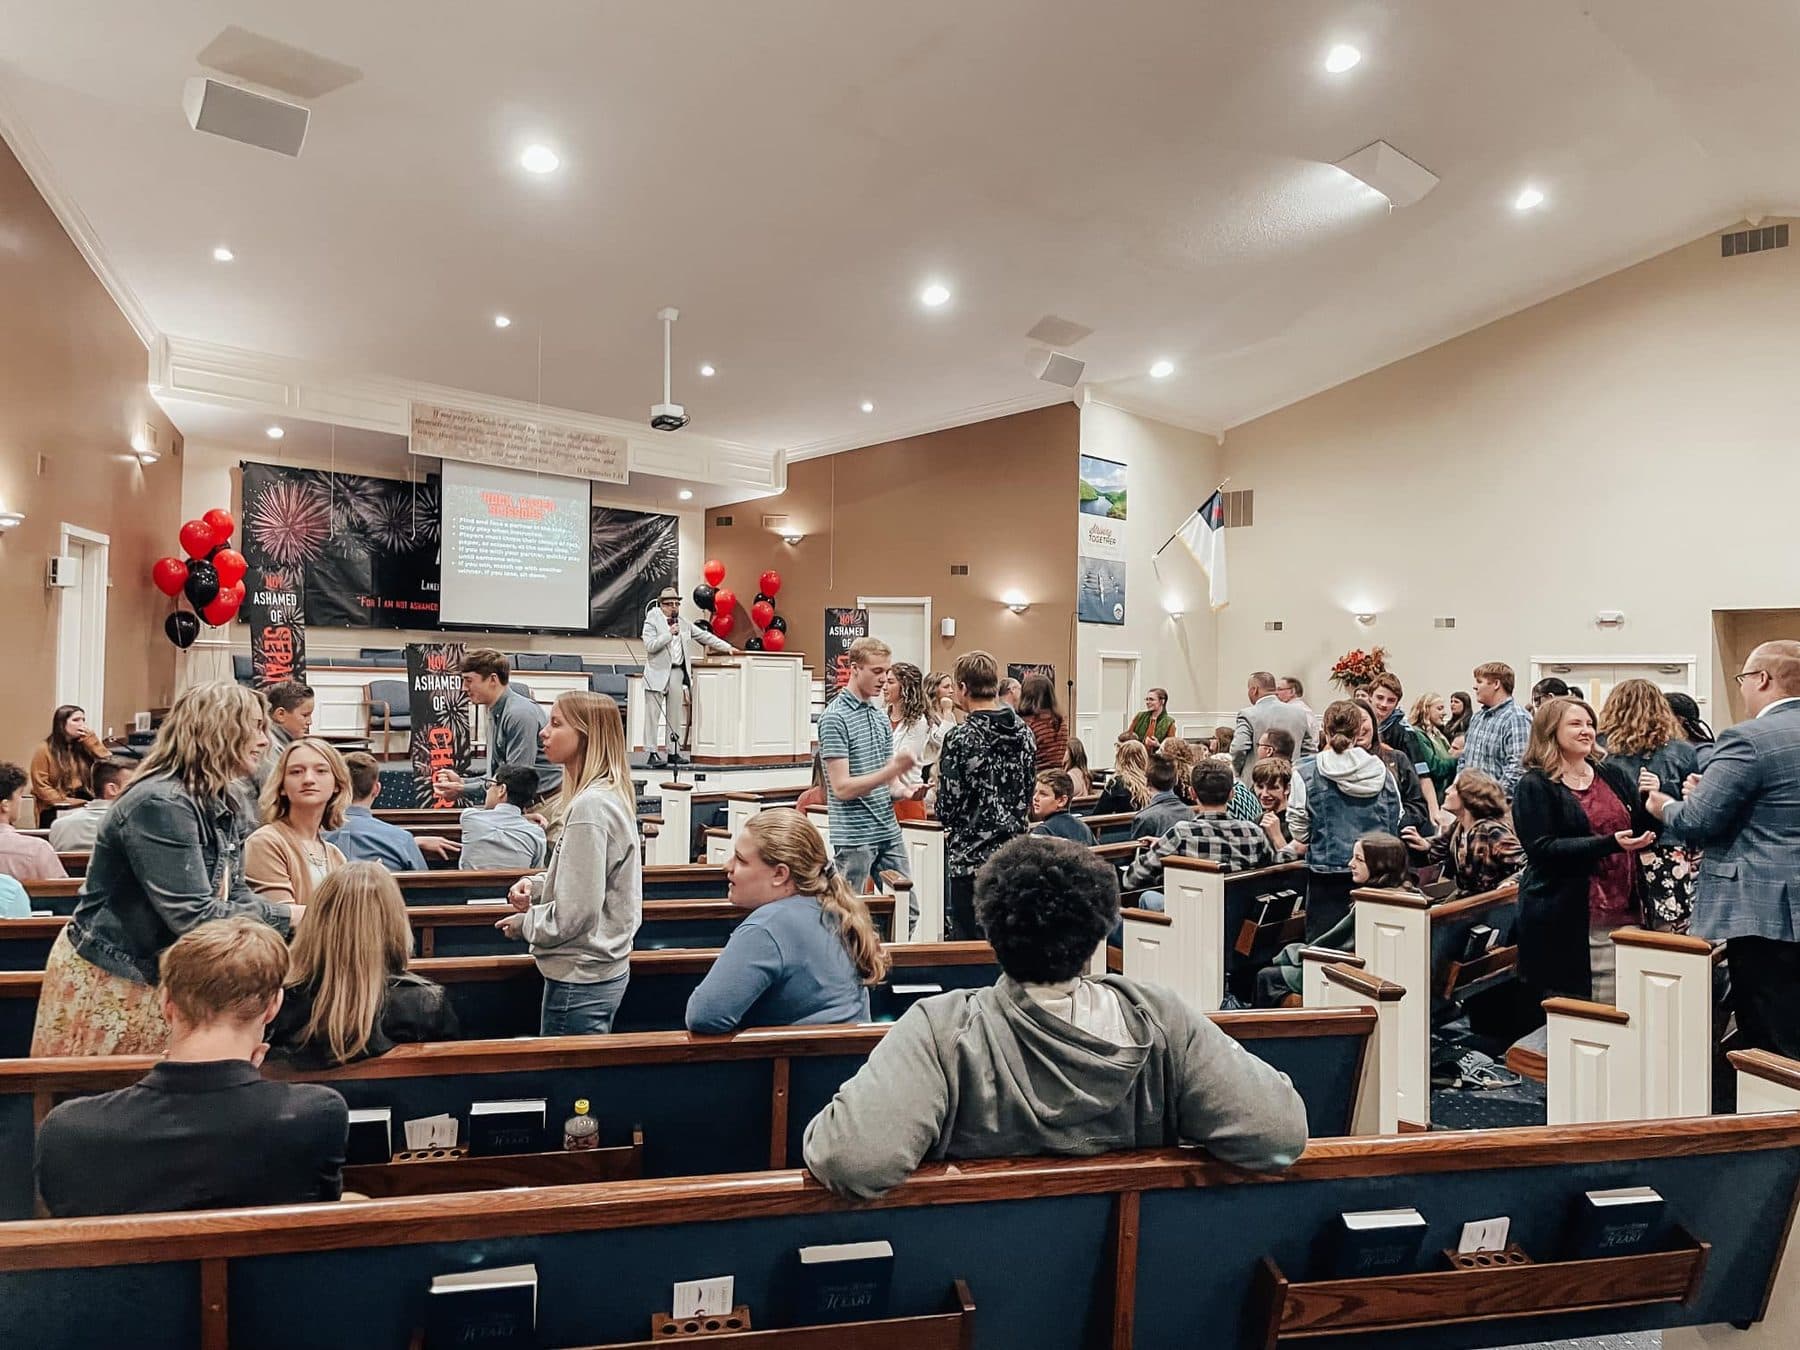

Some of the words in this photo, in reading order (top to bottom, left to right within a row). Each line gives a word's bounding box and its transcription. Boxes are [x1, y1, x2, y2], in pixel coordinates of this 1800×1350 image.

[253, 591, 297, 606] ASHAMED
[396, 601, 408, 609] NOT
[410, 602, 439, 611] ASHAMED
[270, 609, 283, 622] OF
[829, 626, 865, 636] ASHAMED
[842, 638, 852, 648] OF
[414, 675, 462, 692] ASHAMED
[433, 695, 446, 712] OF
